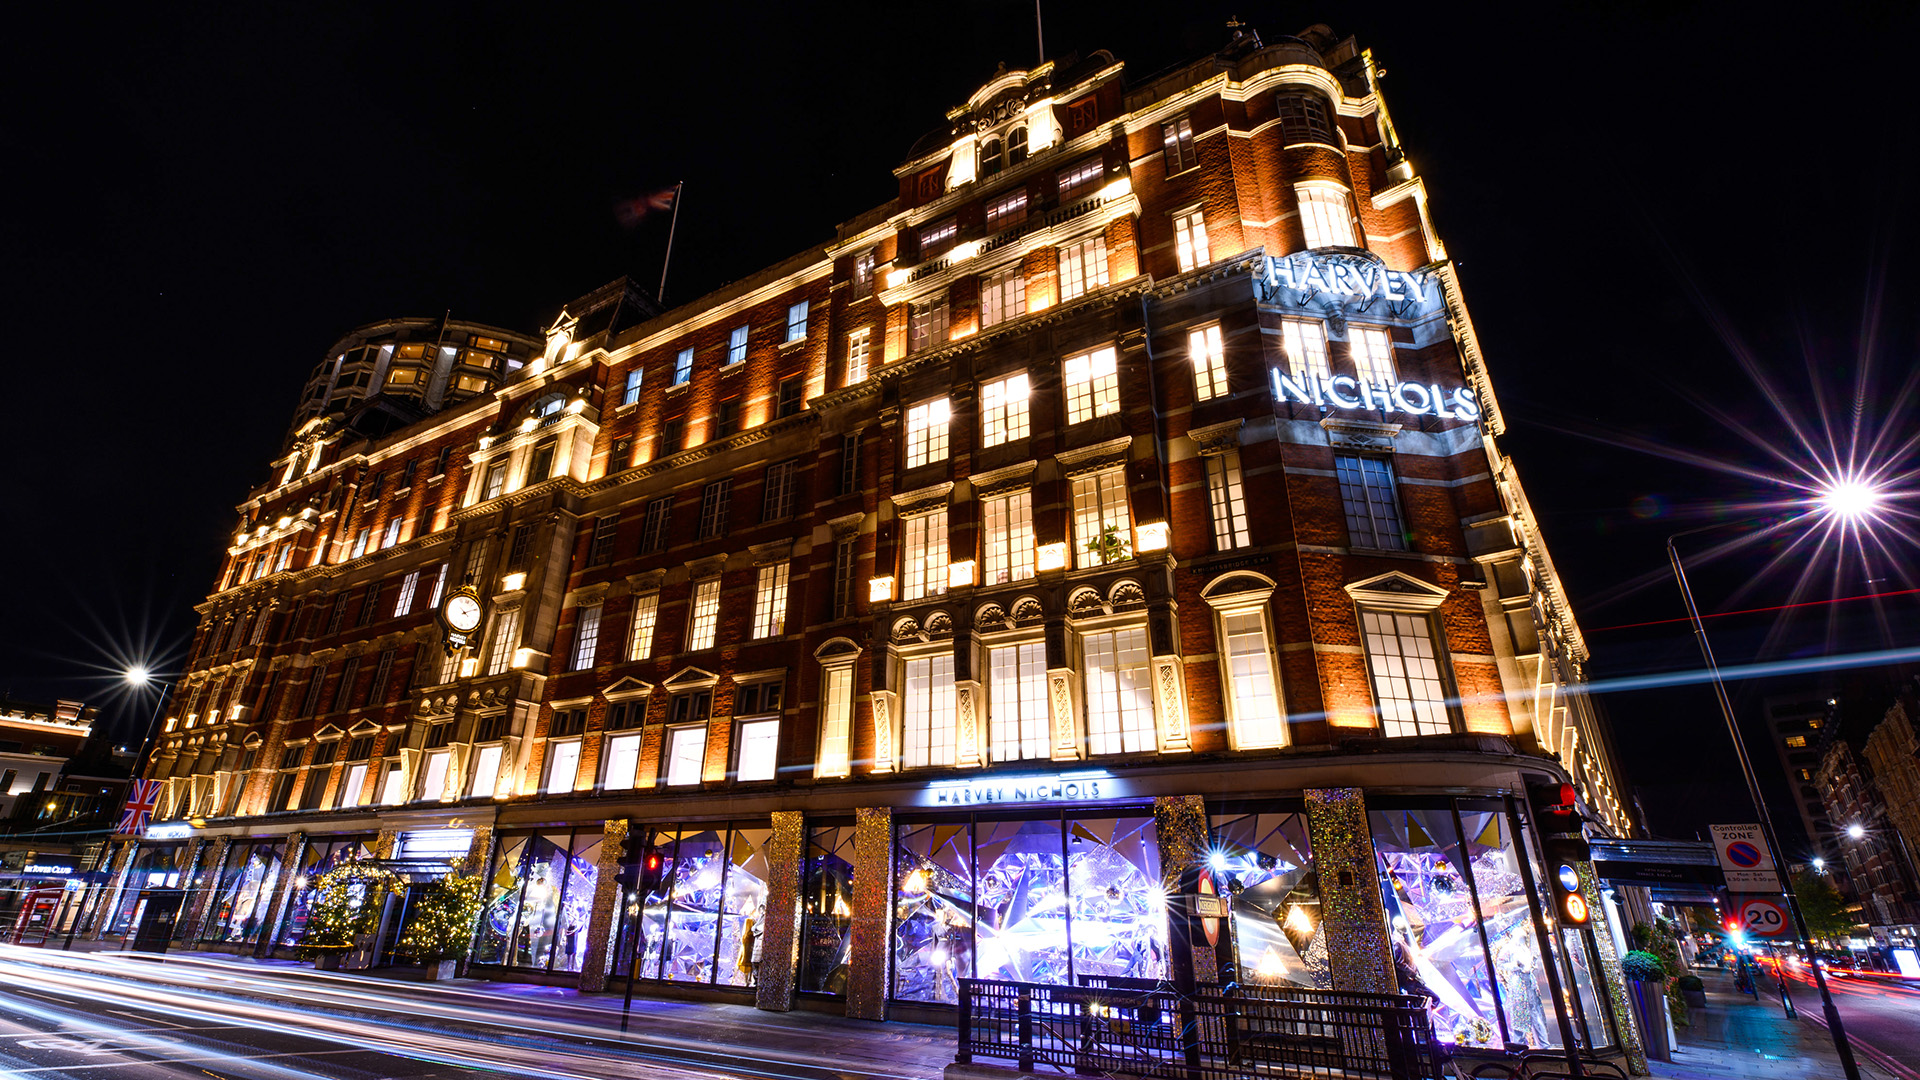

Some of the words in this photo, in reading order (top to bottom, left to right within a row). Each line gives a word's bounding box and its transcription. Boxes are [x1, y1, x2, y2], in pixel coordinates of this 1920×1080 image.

[1266, 256, 1427, 303] HARVEY
[1272, 367, 1479, 421] NICHOLS
[938, 787, 1004, 804] HARVEY
[1015, 782, 1100, 799] NICHOLS
[1722, 832, 1754, 840] ZONE
[52, 865, 73, 874] CLUB
[1747, 910, 1781, 925] 20
